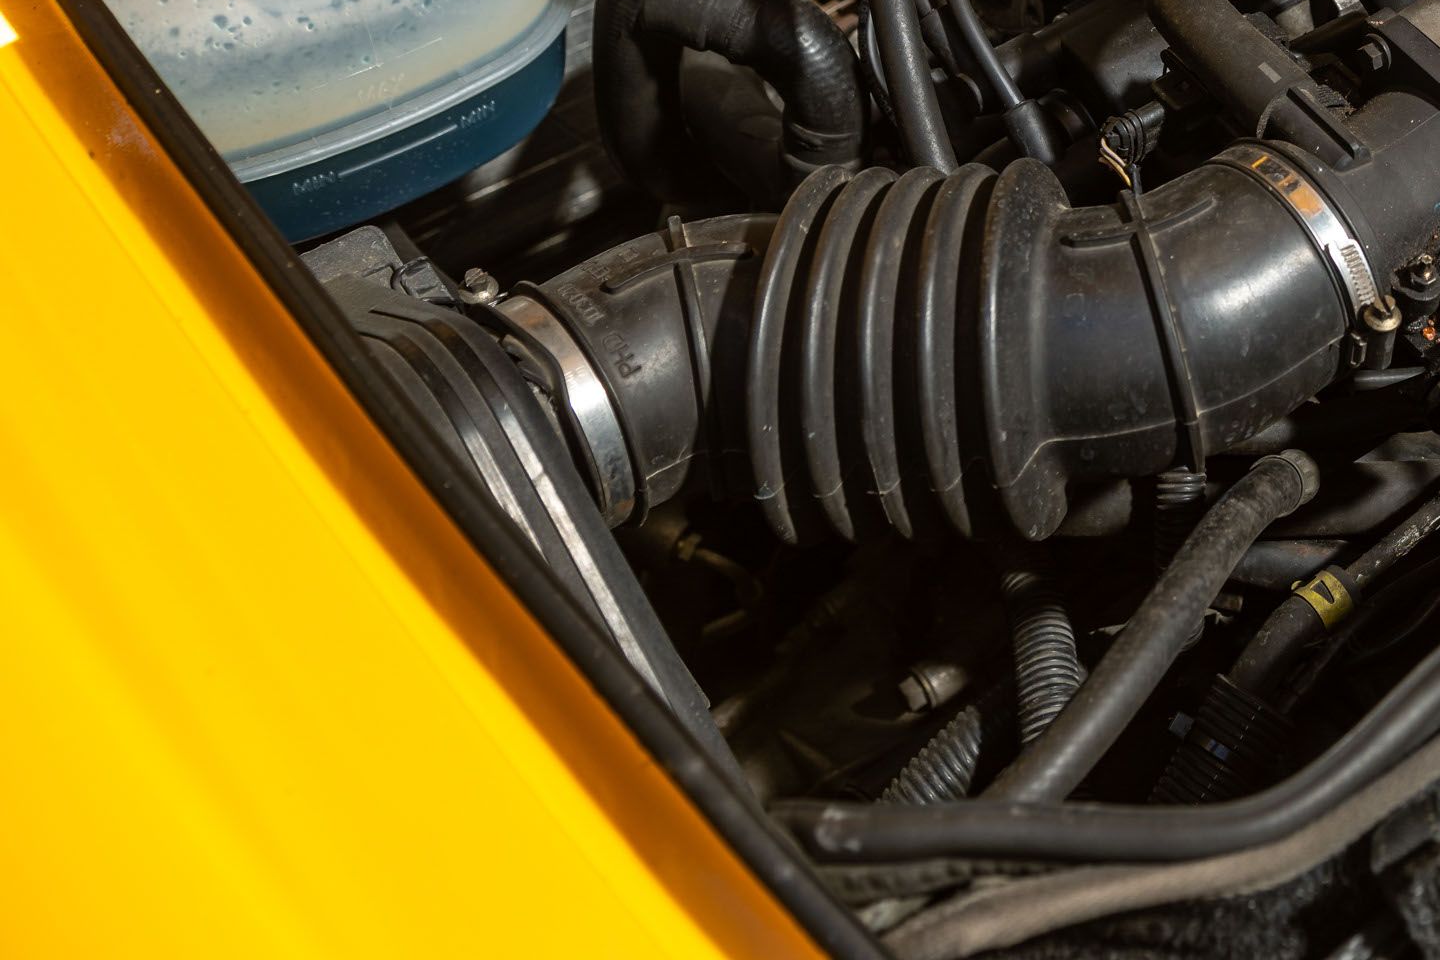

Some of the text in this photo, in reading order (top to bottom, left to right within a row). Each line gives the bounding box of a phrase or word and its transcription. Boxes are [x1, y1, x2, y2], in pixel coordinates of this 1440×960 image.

[460, 100, 496, 128] MIN
[293, 171, 335, 195] MIN
[602, 330, 642, 378] PHD
